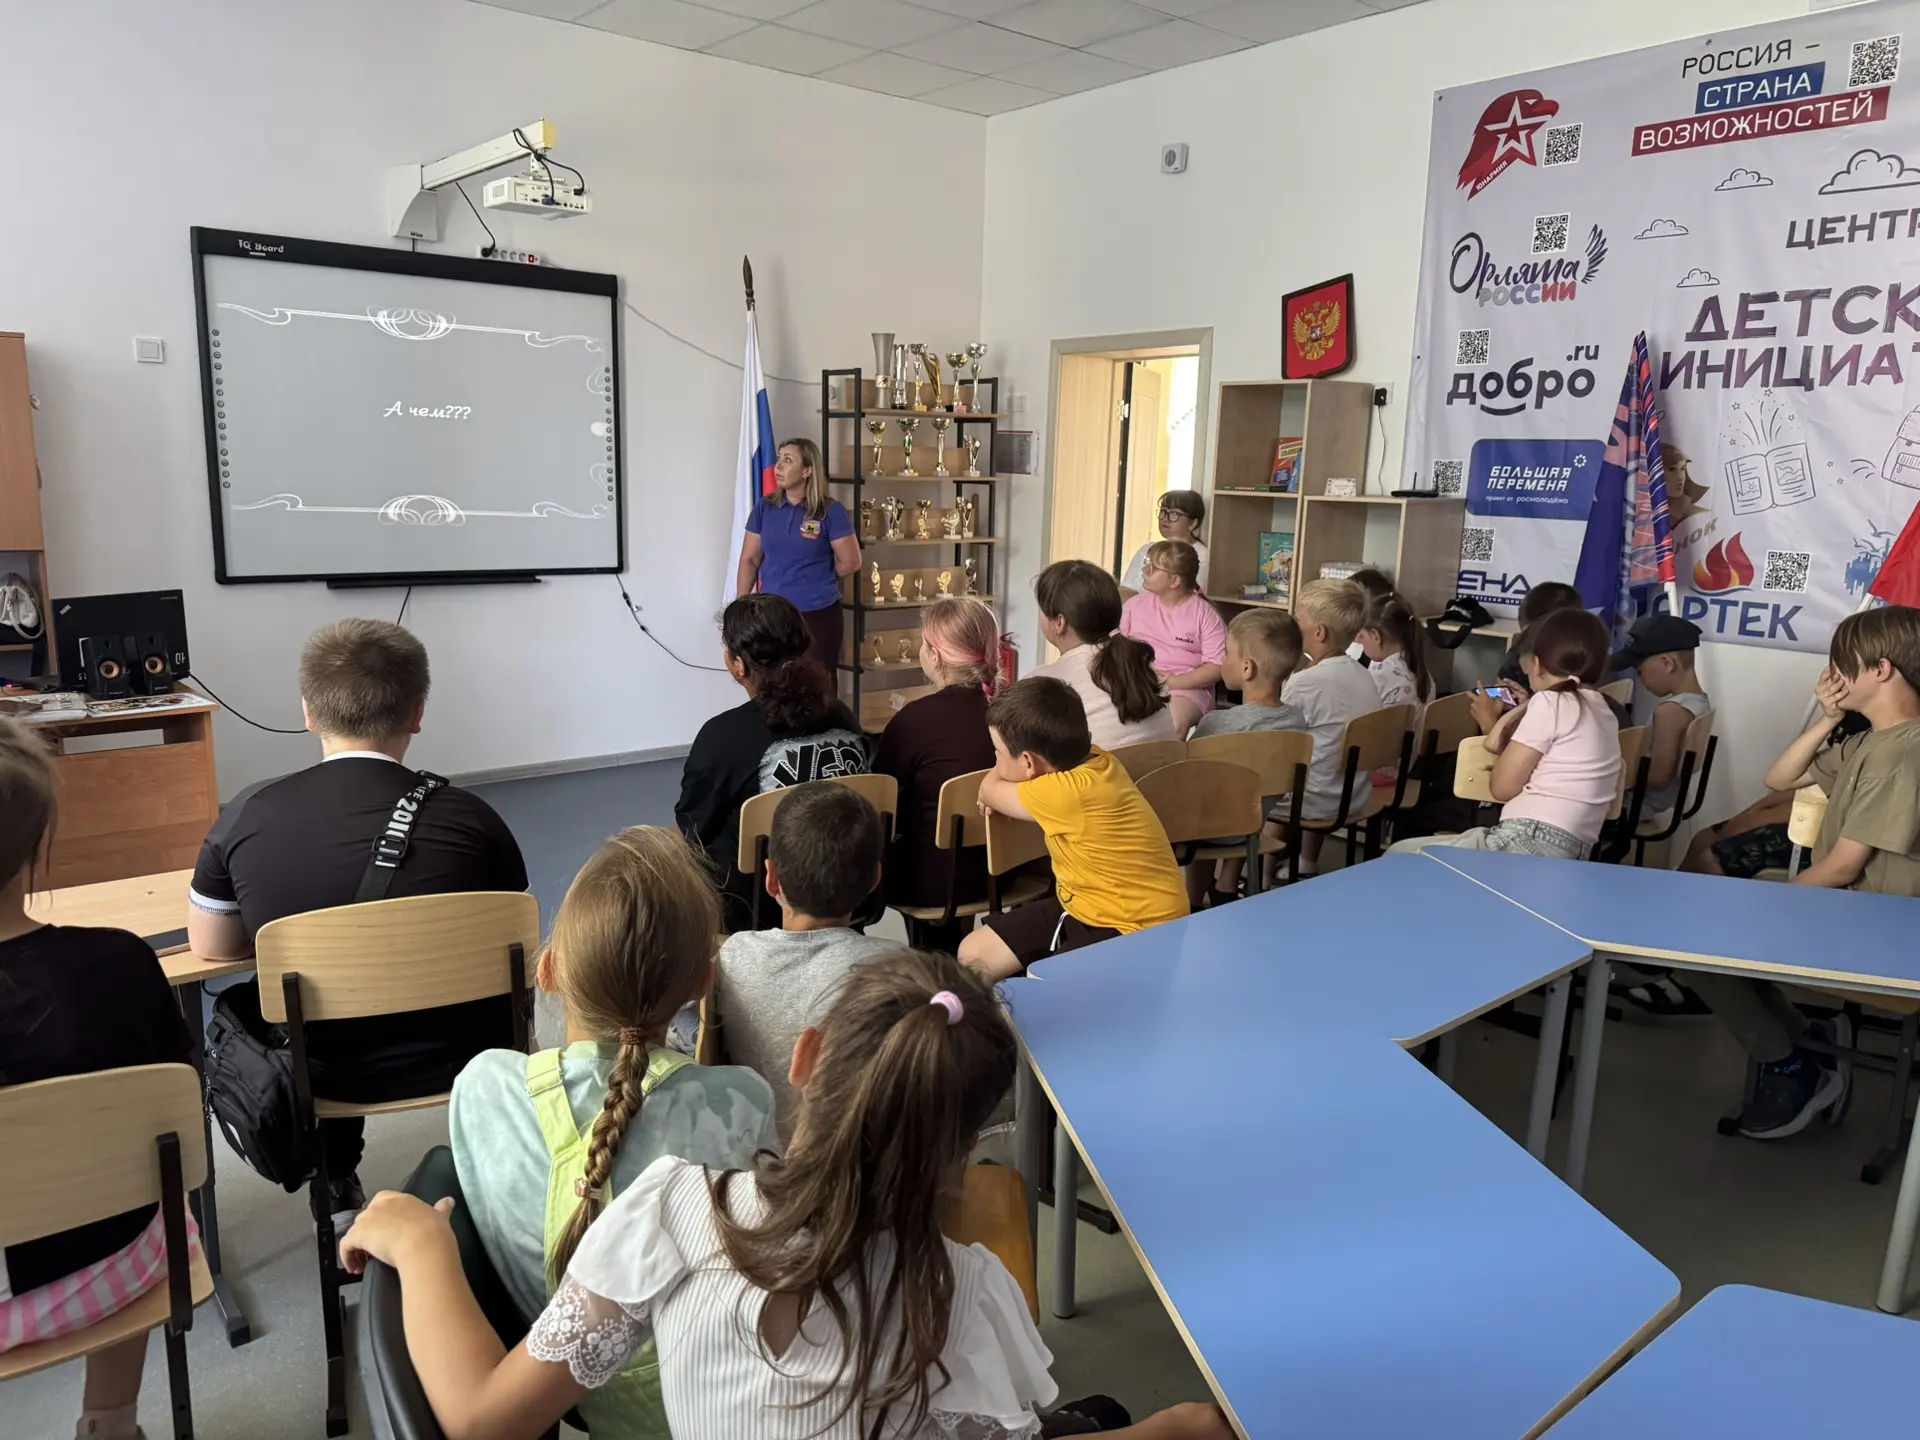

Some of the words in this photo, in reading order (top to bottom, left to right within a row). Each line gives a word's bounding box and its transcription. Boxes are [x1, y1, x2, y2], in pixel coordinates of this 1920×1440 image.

[1682, 39, 1792, 79] РОССИЯ
[1703, 71, 1812, 108] СТРАНА
[1639, 90, 1874, 151] ВОЗМОЖНОСТЕЙ
[1475, 160, 1508, 191] ЮНАРМИЯ
[254, 242, 284, 253] Board
[1449, 232, 1581, 299] Орлята
[1478, 280, 1577, 308] РОССИИ
[1684, 282, 1920, 342] ДЕТСК
[1566, 344, 1600, 362] .ru
[1446, 357, 1596, 410] добро
[383, 400, 404, 418] А
[408, 404, 472, 420] чем???
[1486, 478, 1569, 492] ПЕРЕМЕНА
[1490, 465, 1573, 479] БОЛЬШАЯ
